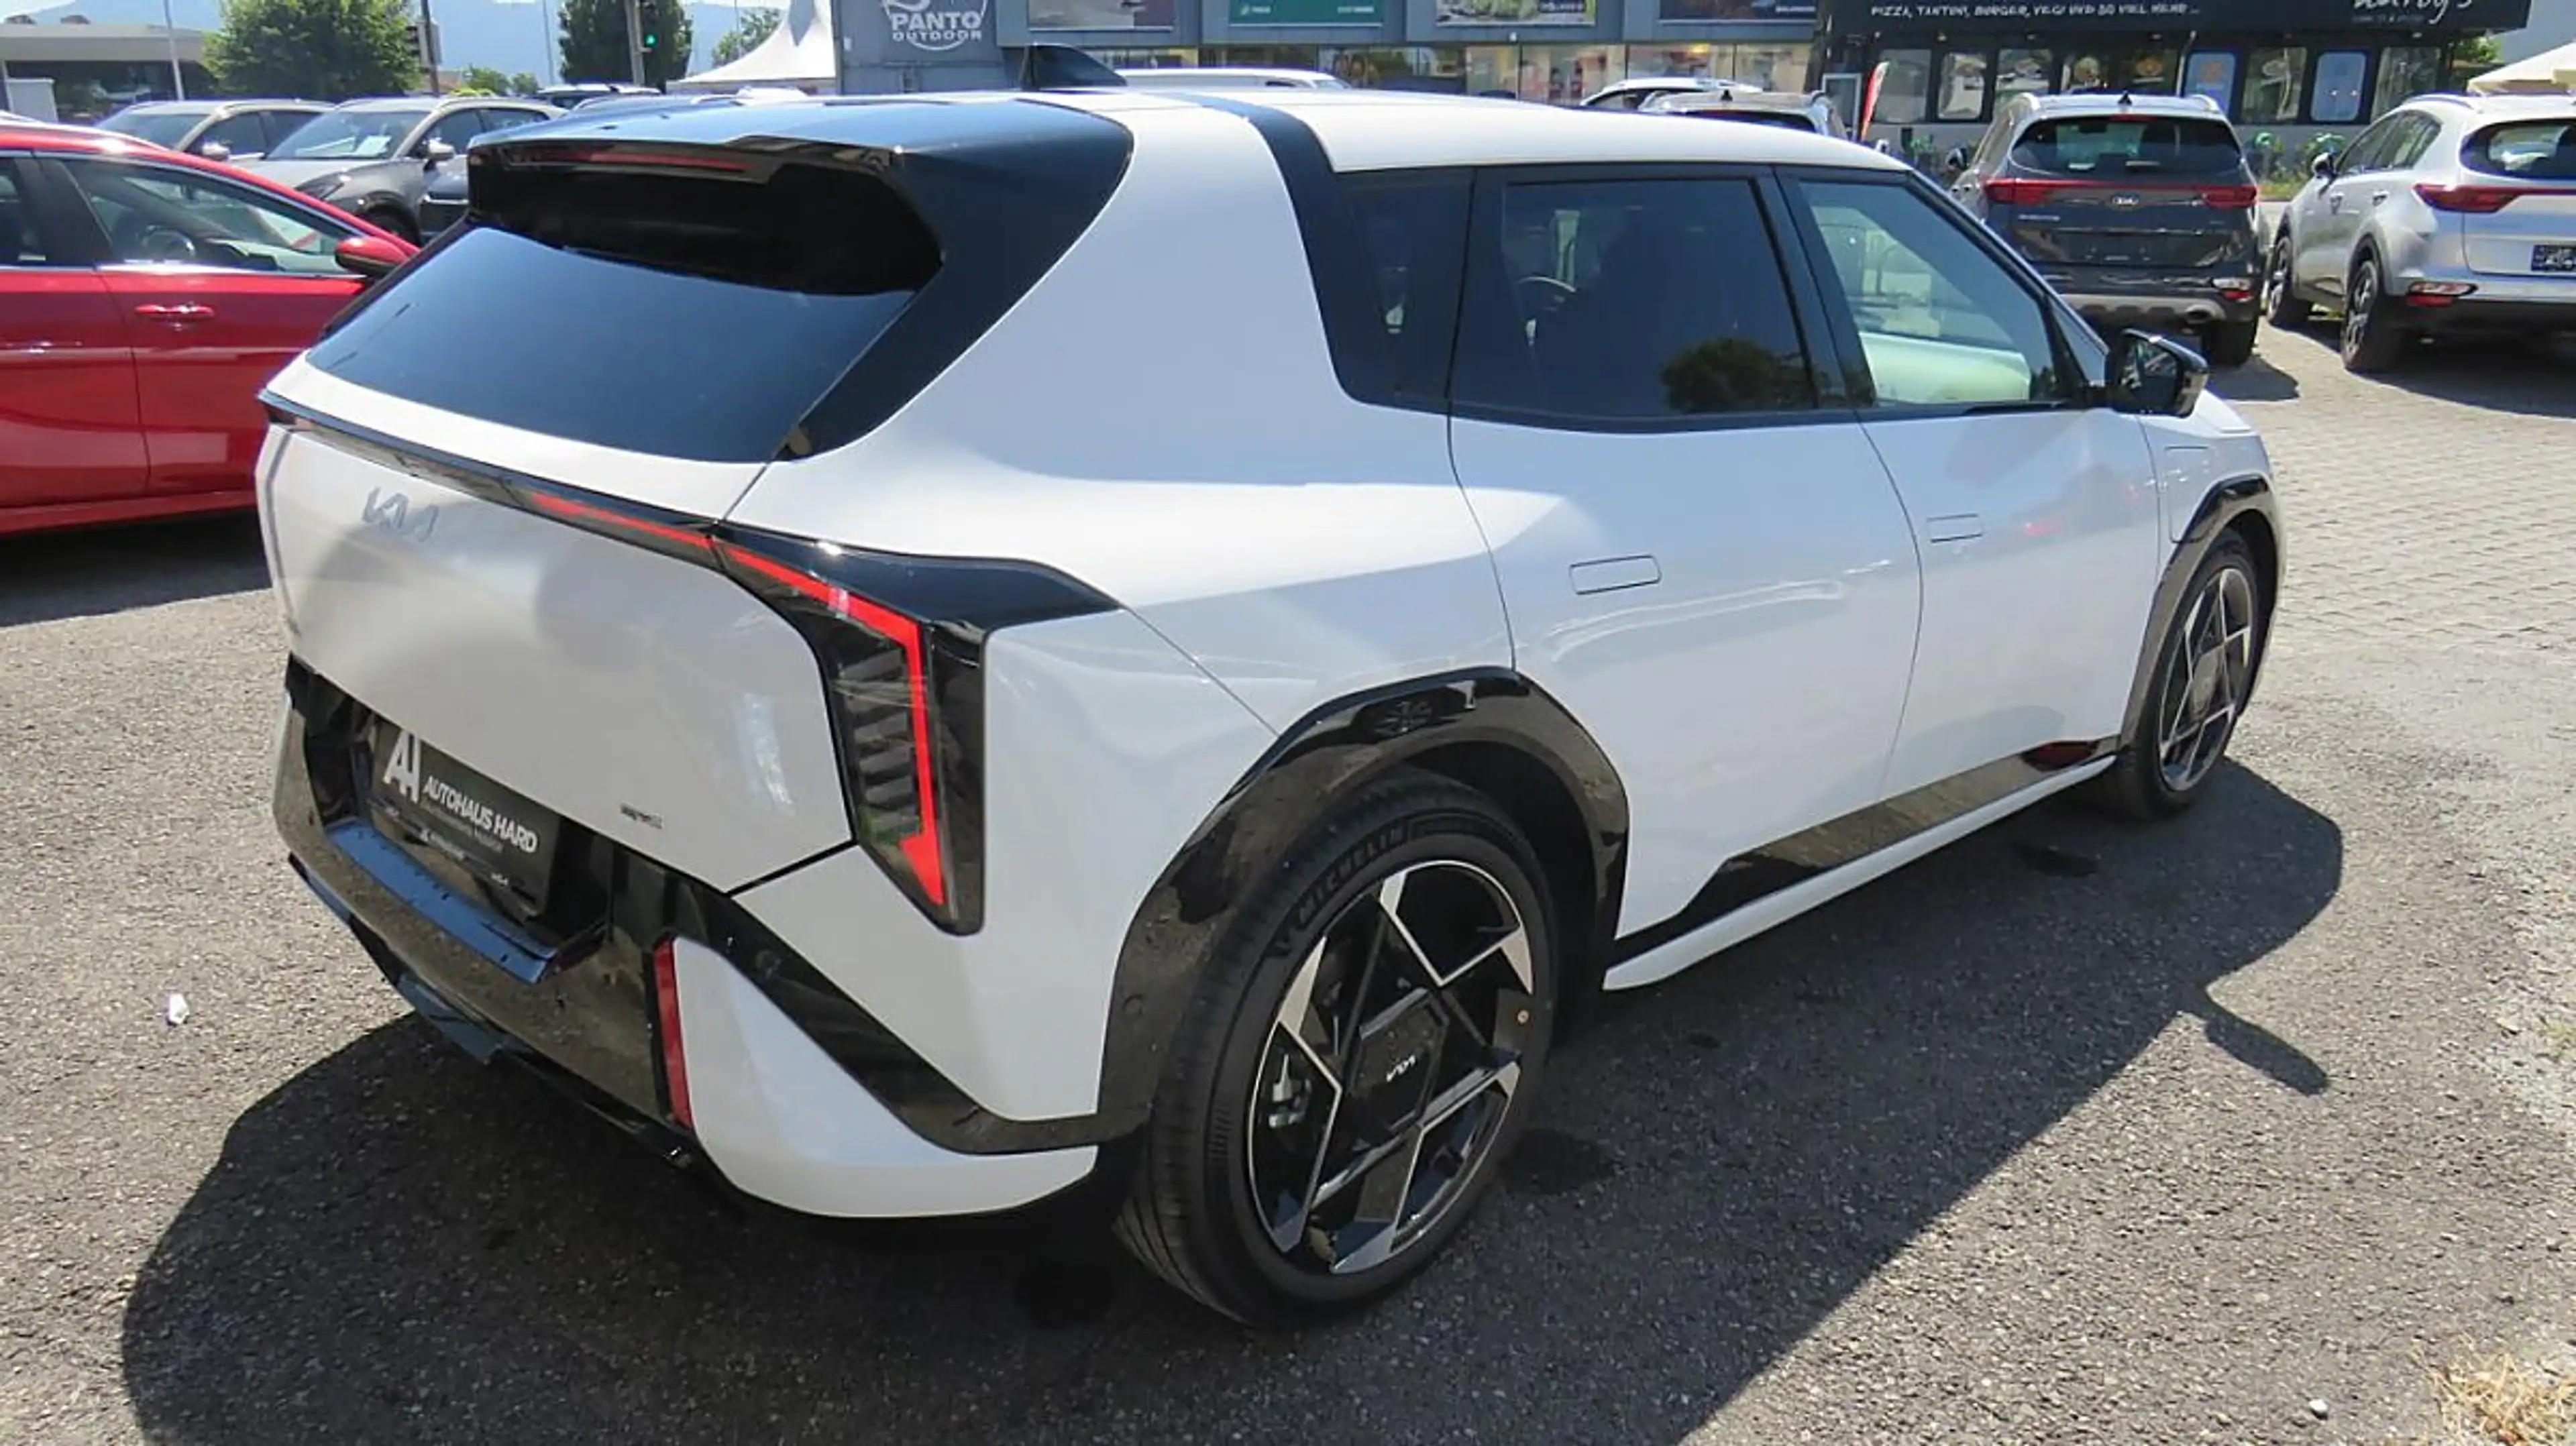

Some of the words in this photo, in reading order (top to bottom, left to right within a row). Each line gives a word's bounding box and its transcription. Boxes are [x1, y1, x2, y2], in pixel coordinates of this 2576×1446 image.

[2069, 4, 2096, 16] UND
[892, 11, 981, 31] PANTO
[892, 30, 982, 42] OUTDOOR
[423, 775, 494, 831] AUTOHAUS
[493, 813, 538, 853] HARD
[1298, 825, 1405, 923] MICHELIN
